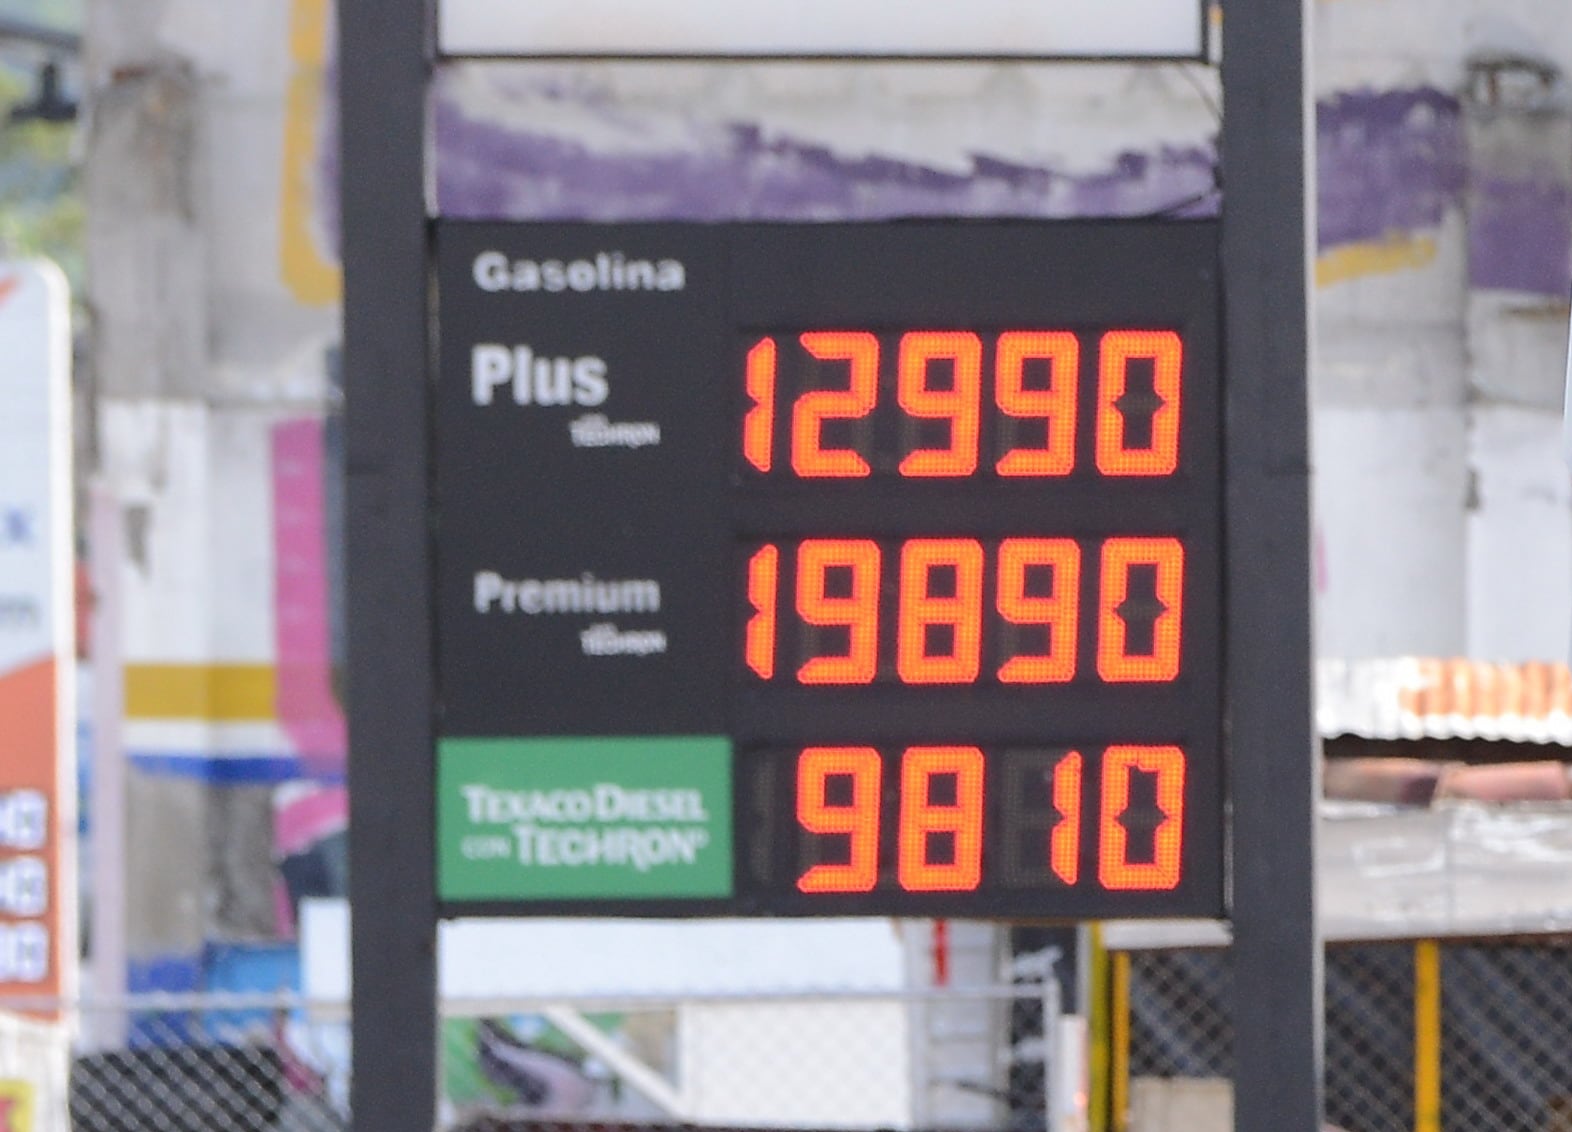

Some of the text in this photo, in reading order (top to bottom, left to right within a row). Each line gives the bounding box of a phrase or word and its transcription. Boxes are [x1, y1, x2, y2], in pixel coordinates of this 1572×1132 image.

[472, 252, 686, 293] Gasolina
[471, 330, 1184, 477] Plus 12990
[473, 537, 1185, 684] Premium 19890
[461, 745, 1186, 893] TEXACO DIESEL 9810
[515, 825, 708, 872] TECHRON
